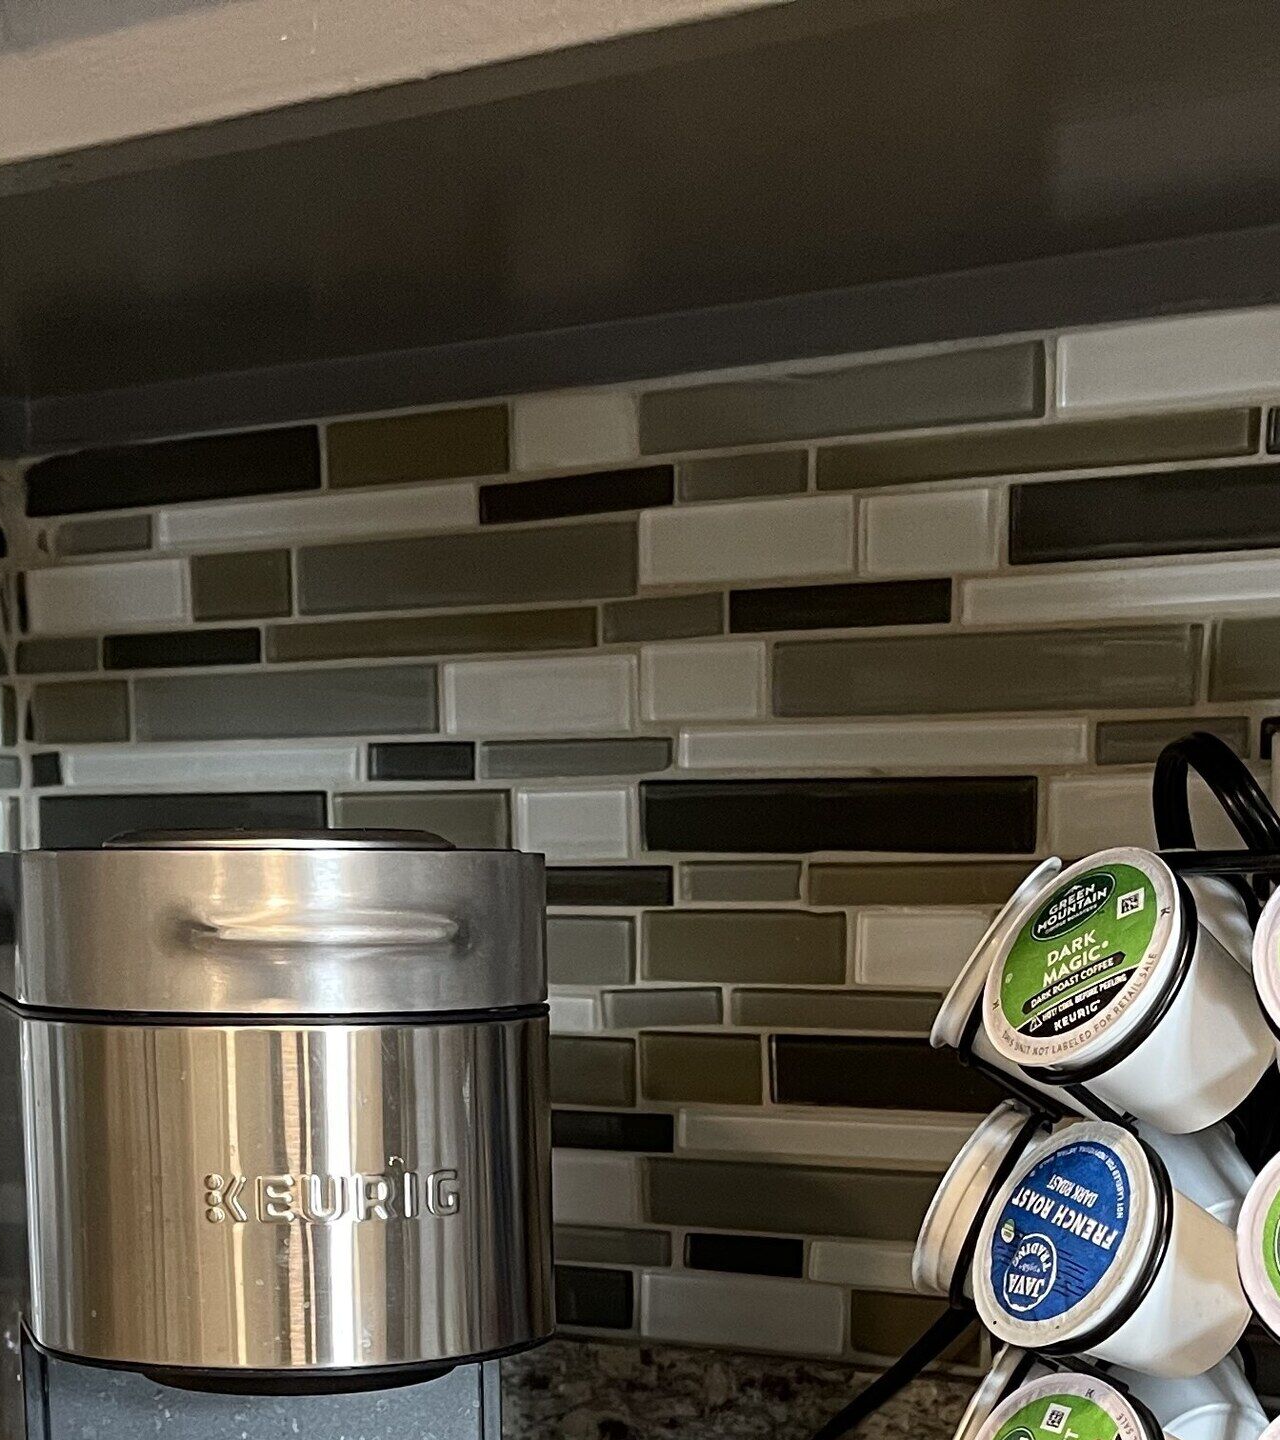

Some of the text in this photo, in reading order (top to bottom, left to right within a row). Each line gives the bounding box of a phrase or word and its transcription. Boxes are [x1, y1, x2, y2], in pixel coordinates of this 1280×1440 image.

[1037, 887, 1107, 934] MOUNTAIN
[1049, 884, 1096, 915] GREEN
[1047, 931, 1096, 966] DARK
[1030, 957, 1114, 1008] DARK ROAST COFFEE
[1049, 1027, 1092, 1054] LABELED
[1093, 1013, 1113, 1032] FOR
[1113, 983, 1139, 1017] RETAIL
[1139, 953, 1158, 978] SALE
[1053, 1001, 1101, 1031] KEURIG
[204, 1170, 462, 1223] KEURIG
[1046, 1174, 1099, 1208] DARK ROAST
[1012, 1187, 1119, 1250] FRENCH ROAST
[1009, 1273, 1046, 1297] JAVA
[1117, 1414, 1132, 1436] SALE
